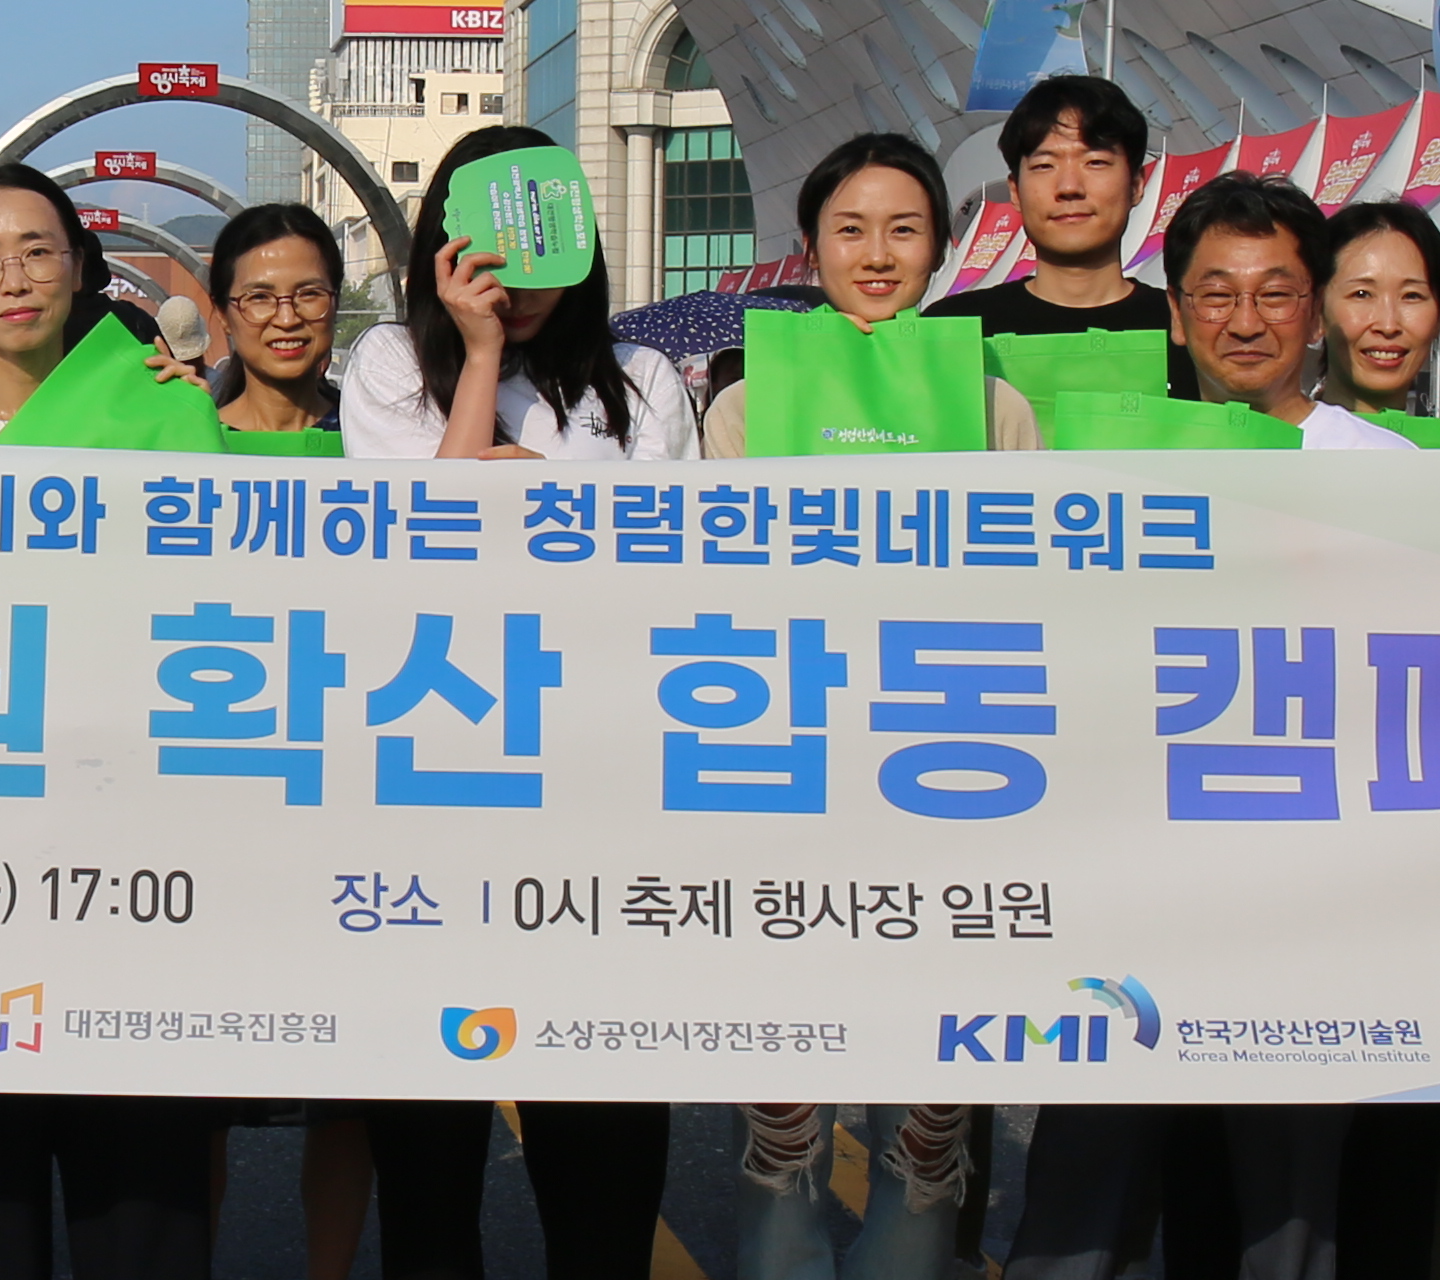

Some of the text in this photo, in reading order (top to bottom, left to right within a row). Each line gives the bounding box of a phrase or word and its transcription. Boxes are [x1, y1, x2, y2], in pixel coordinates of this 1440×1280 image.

[142, 477, 483, 564] 함께하는
[521, 481, 1217, 572] 청렴한빛네트워크
[146, 601, 563, 808] 확산
[648, 611, 1058, 822] 합동
[38, 866, 195, 925] 17:00
[330, 871, 444, 933] 장소
[513, 876, 602, 936] 0시
[619, 875, 733, 939] 축제
[751, 877, 924, 941] 행사장
[941, 880, 1055, 941] 일원
[63, 1008, 338, 1045] 대전평생교육진흥원
[534, 1019, 848, 1053] 소상공인시장진흥공단
[936, 1014, 1110, 1063] KMI
[1175, 1018, 1424, 1048] 한국기상산업기술원
[1178, 1048, 1431, 1066] Korea Meteorological Institute
